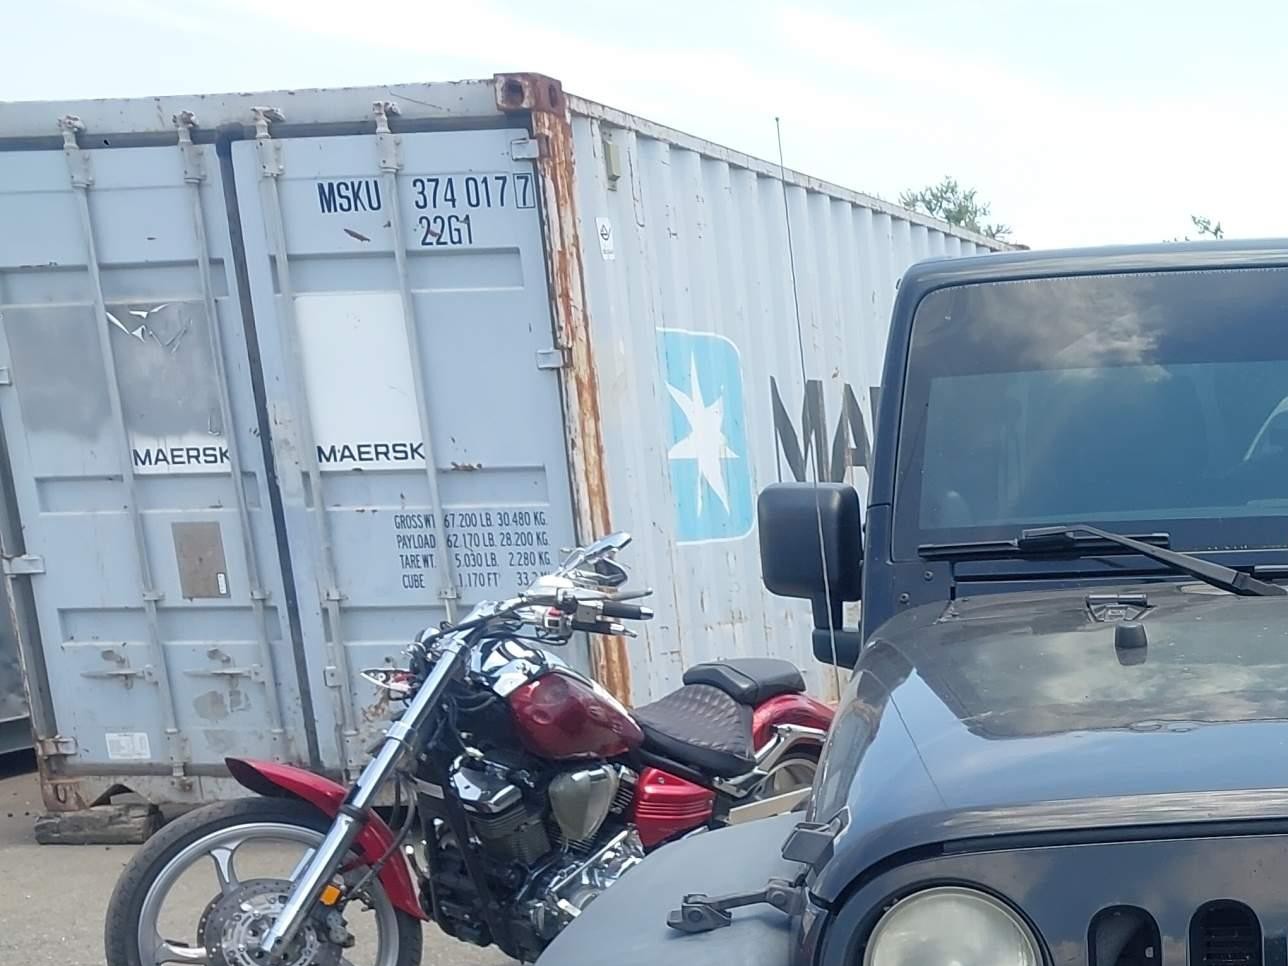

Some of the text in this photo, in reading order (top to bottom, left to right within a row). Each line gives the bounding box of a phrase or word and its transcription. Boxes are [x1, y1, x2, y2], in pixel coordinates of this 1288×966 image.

[317, 175, 530, 213] MSKU 374 017 7
[418, 214, 473, 246] 22G1
[132, 446, 231, 466] MAERSK
[317, 442, 427, 463] MAERSK
[394, 514, 423, 529] GROSS
[396, 534, 436, 549] PAYLOAD
[400, 554, 421, 569] TARE
[402, 574, 425, 588] CUBE
